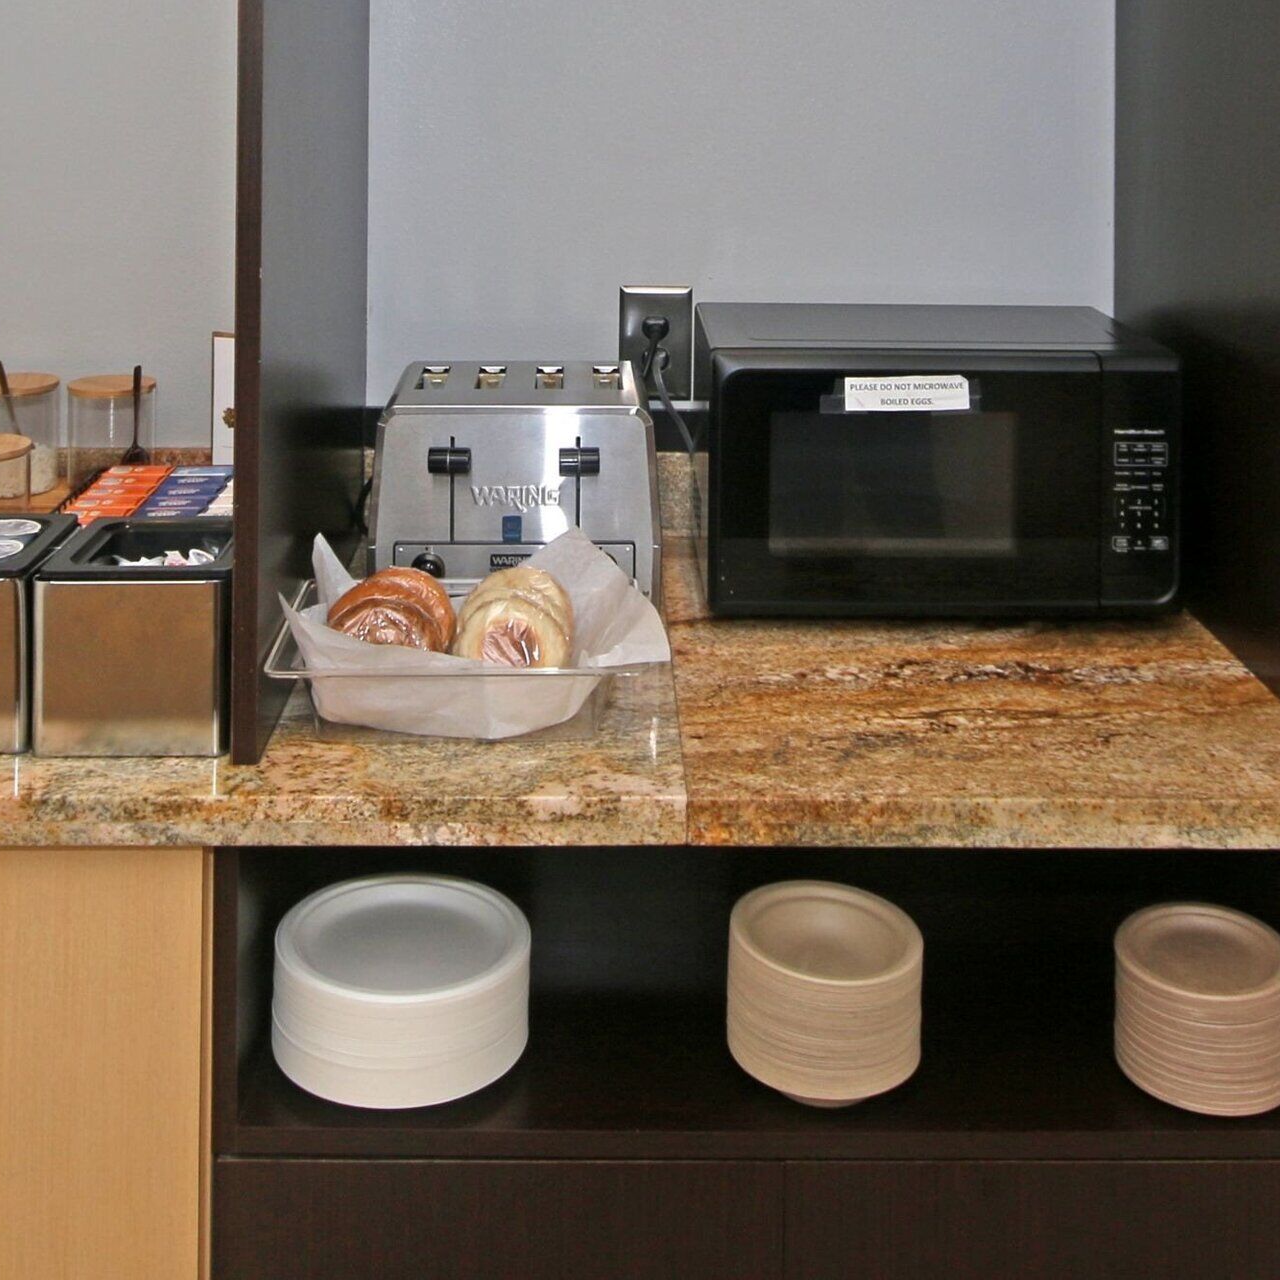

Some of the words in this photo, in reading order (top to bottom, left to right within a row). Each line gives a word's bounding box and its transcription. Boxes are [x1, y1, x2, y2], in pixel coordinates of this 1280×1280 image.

[850, 383, 878, 391] PLEASE
[880, 383, 893, 391] DO
[894, 383, 911, 391] NOT
[913, 382, 965, 391] MICROWAVE
[880, 398, 908, 406] BOILED
[911, 398, 934, 406] EGGS.
[471, 485, 561, 513] WARING
[492, 555, 528, 566] WARIN
